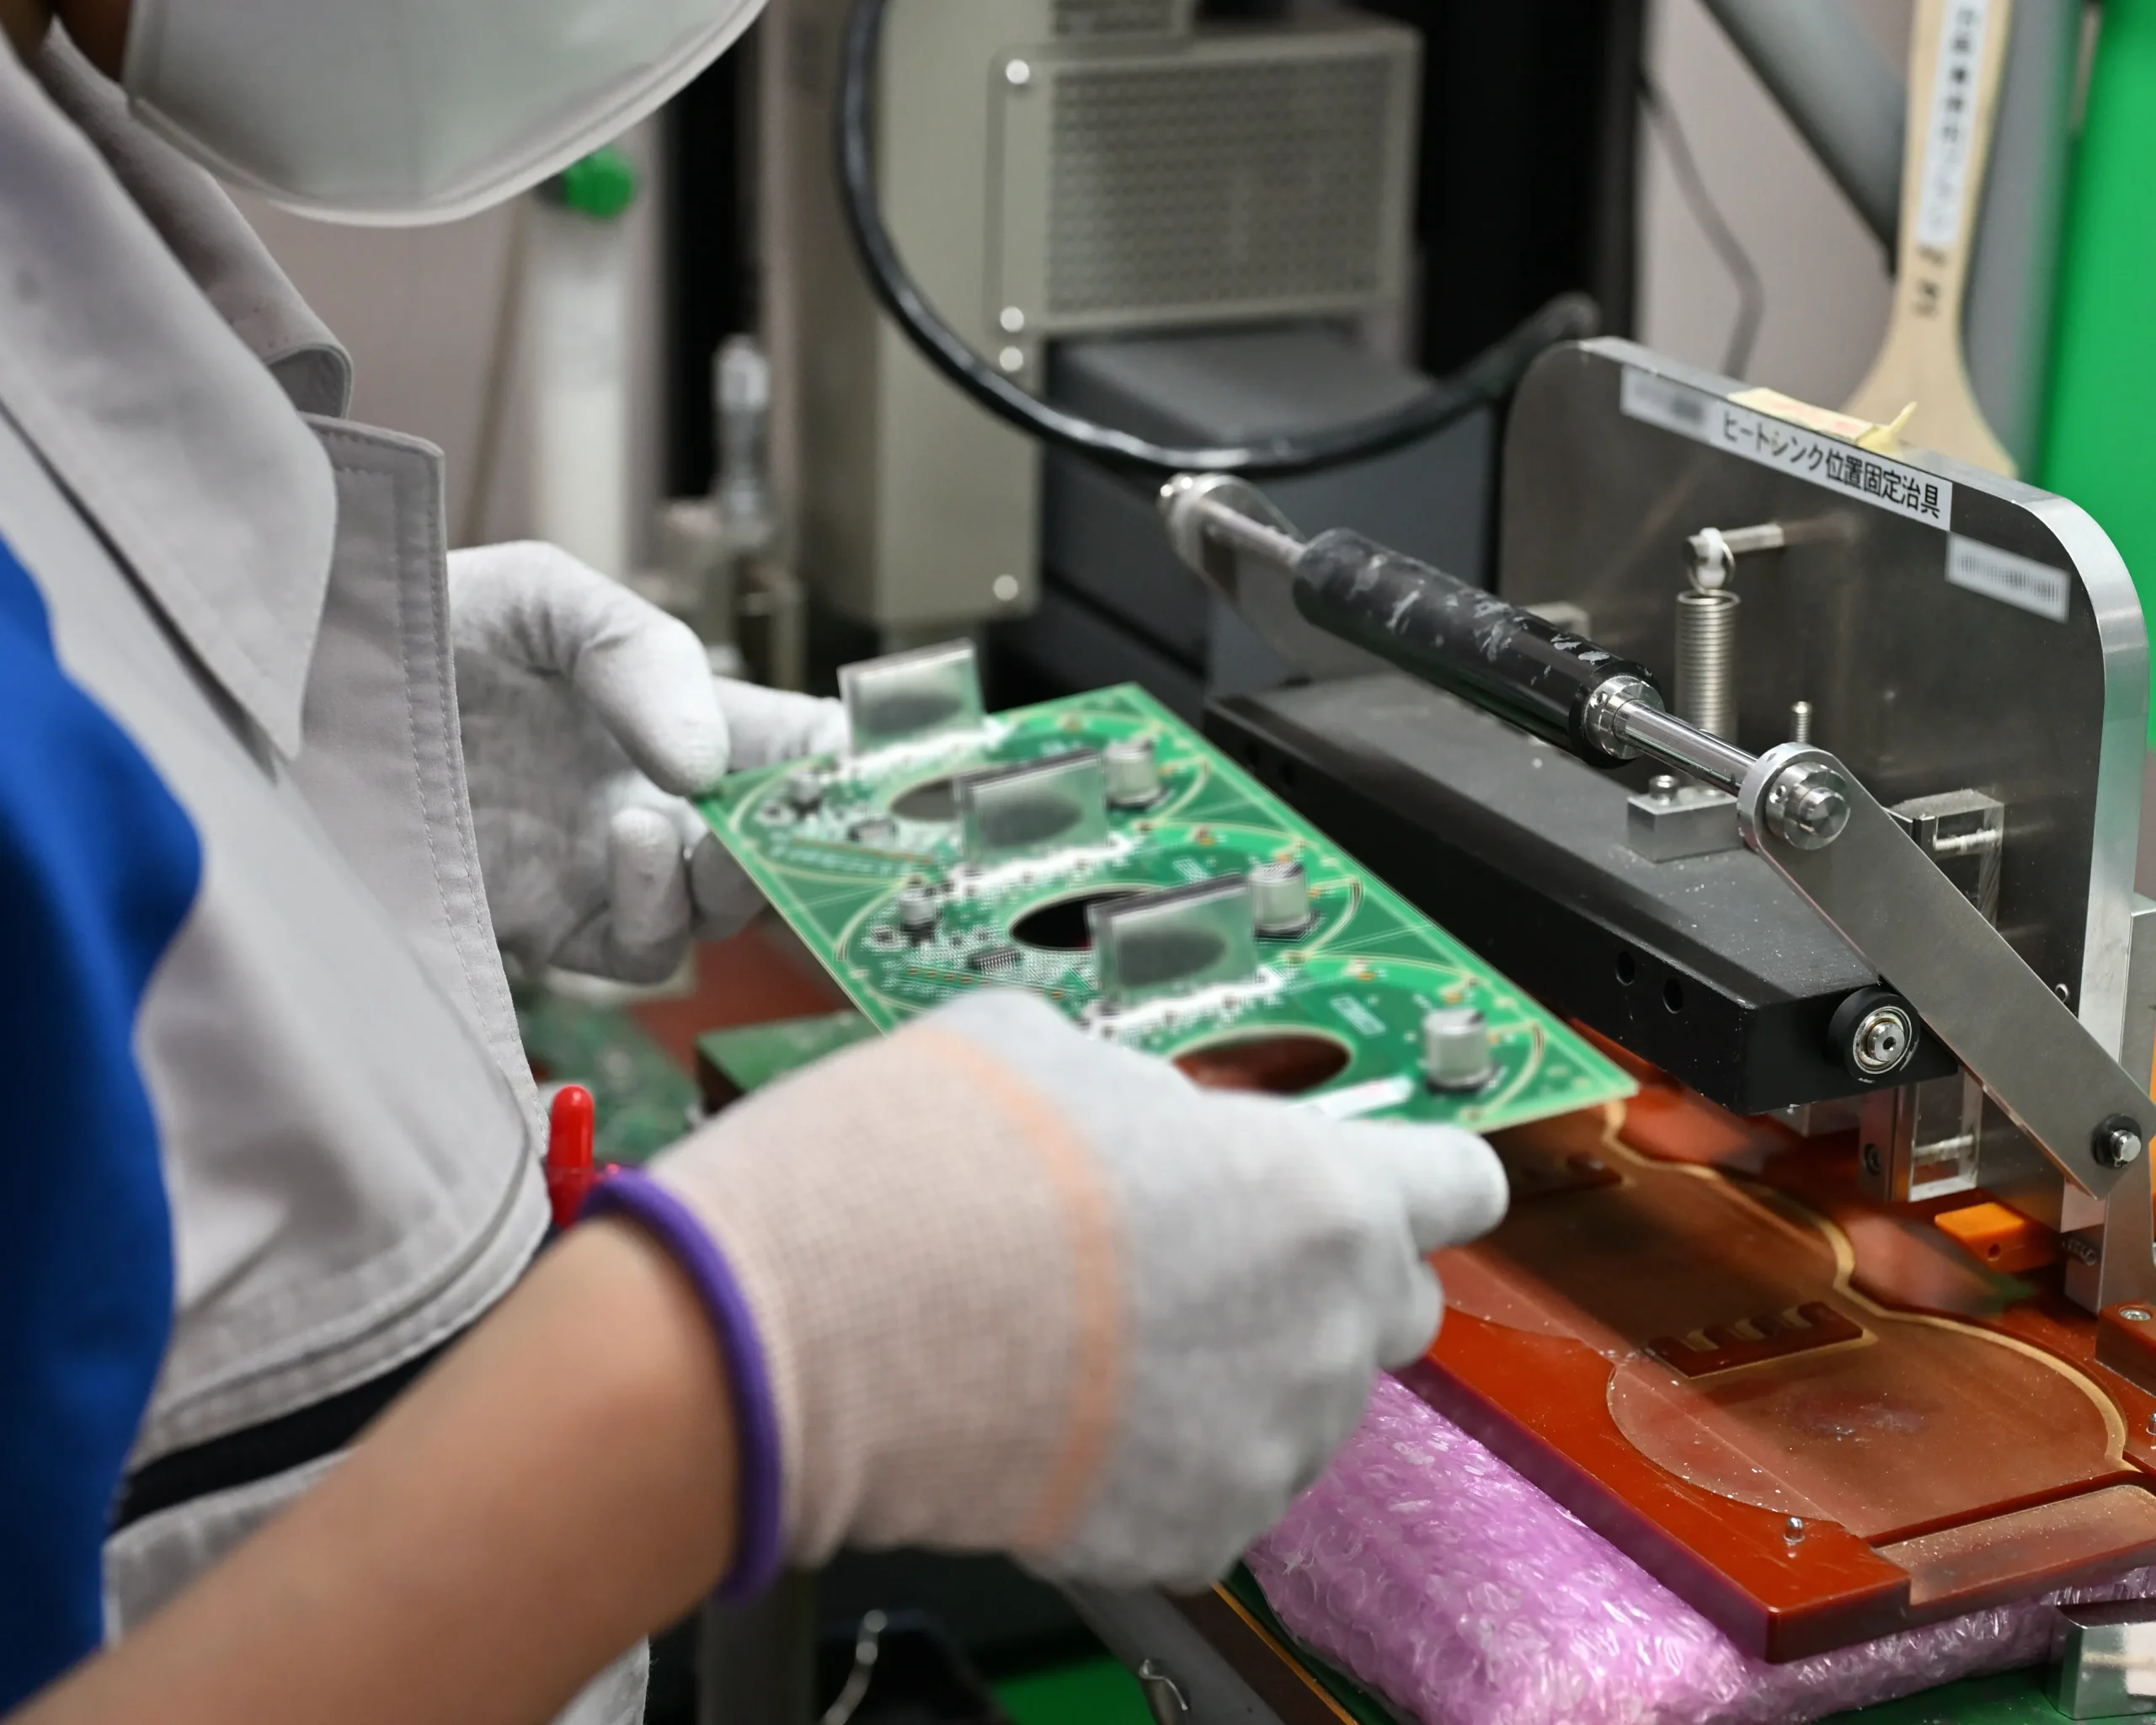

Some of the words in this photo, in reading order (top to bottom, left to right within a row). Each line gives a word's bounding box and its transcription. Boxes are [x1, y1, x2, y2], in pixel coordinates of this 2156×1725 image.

[1723, 411, 1940, 519] ヒートシンク位置固定治具
